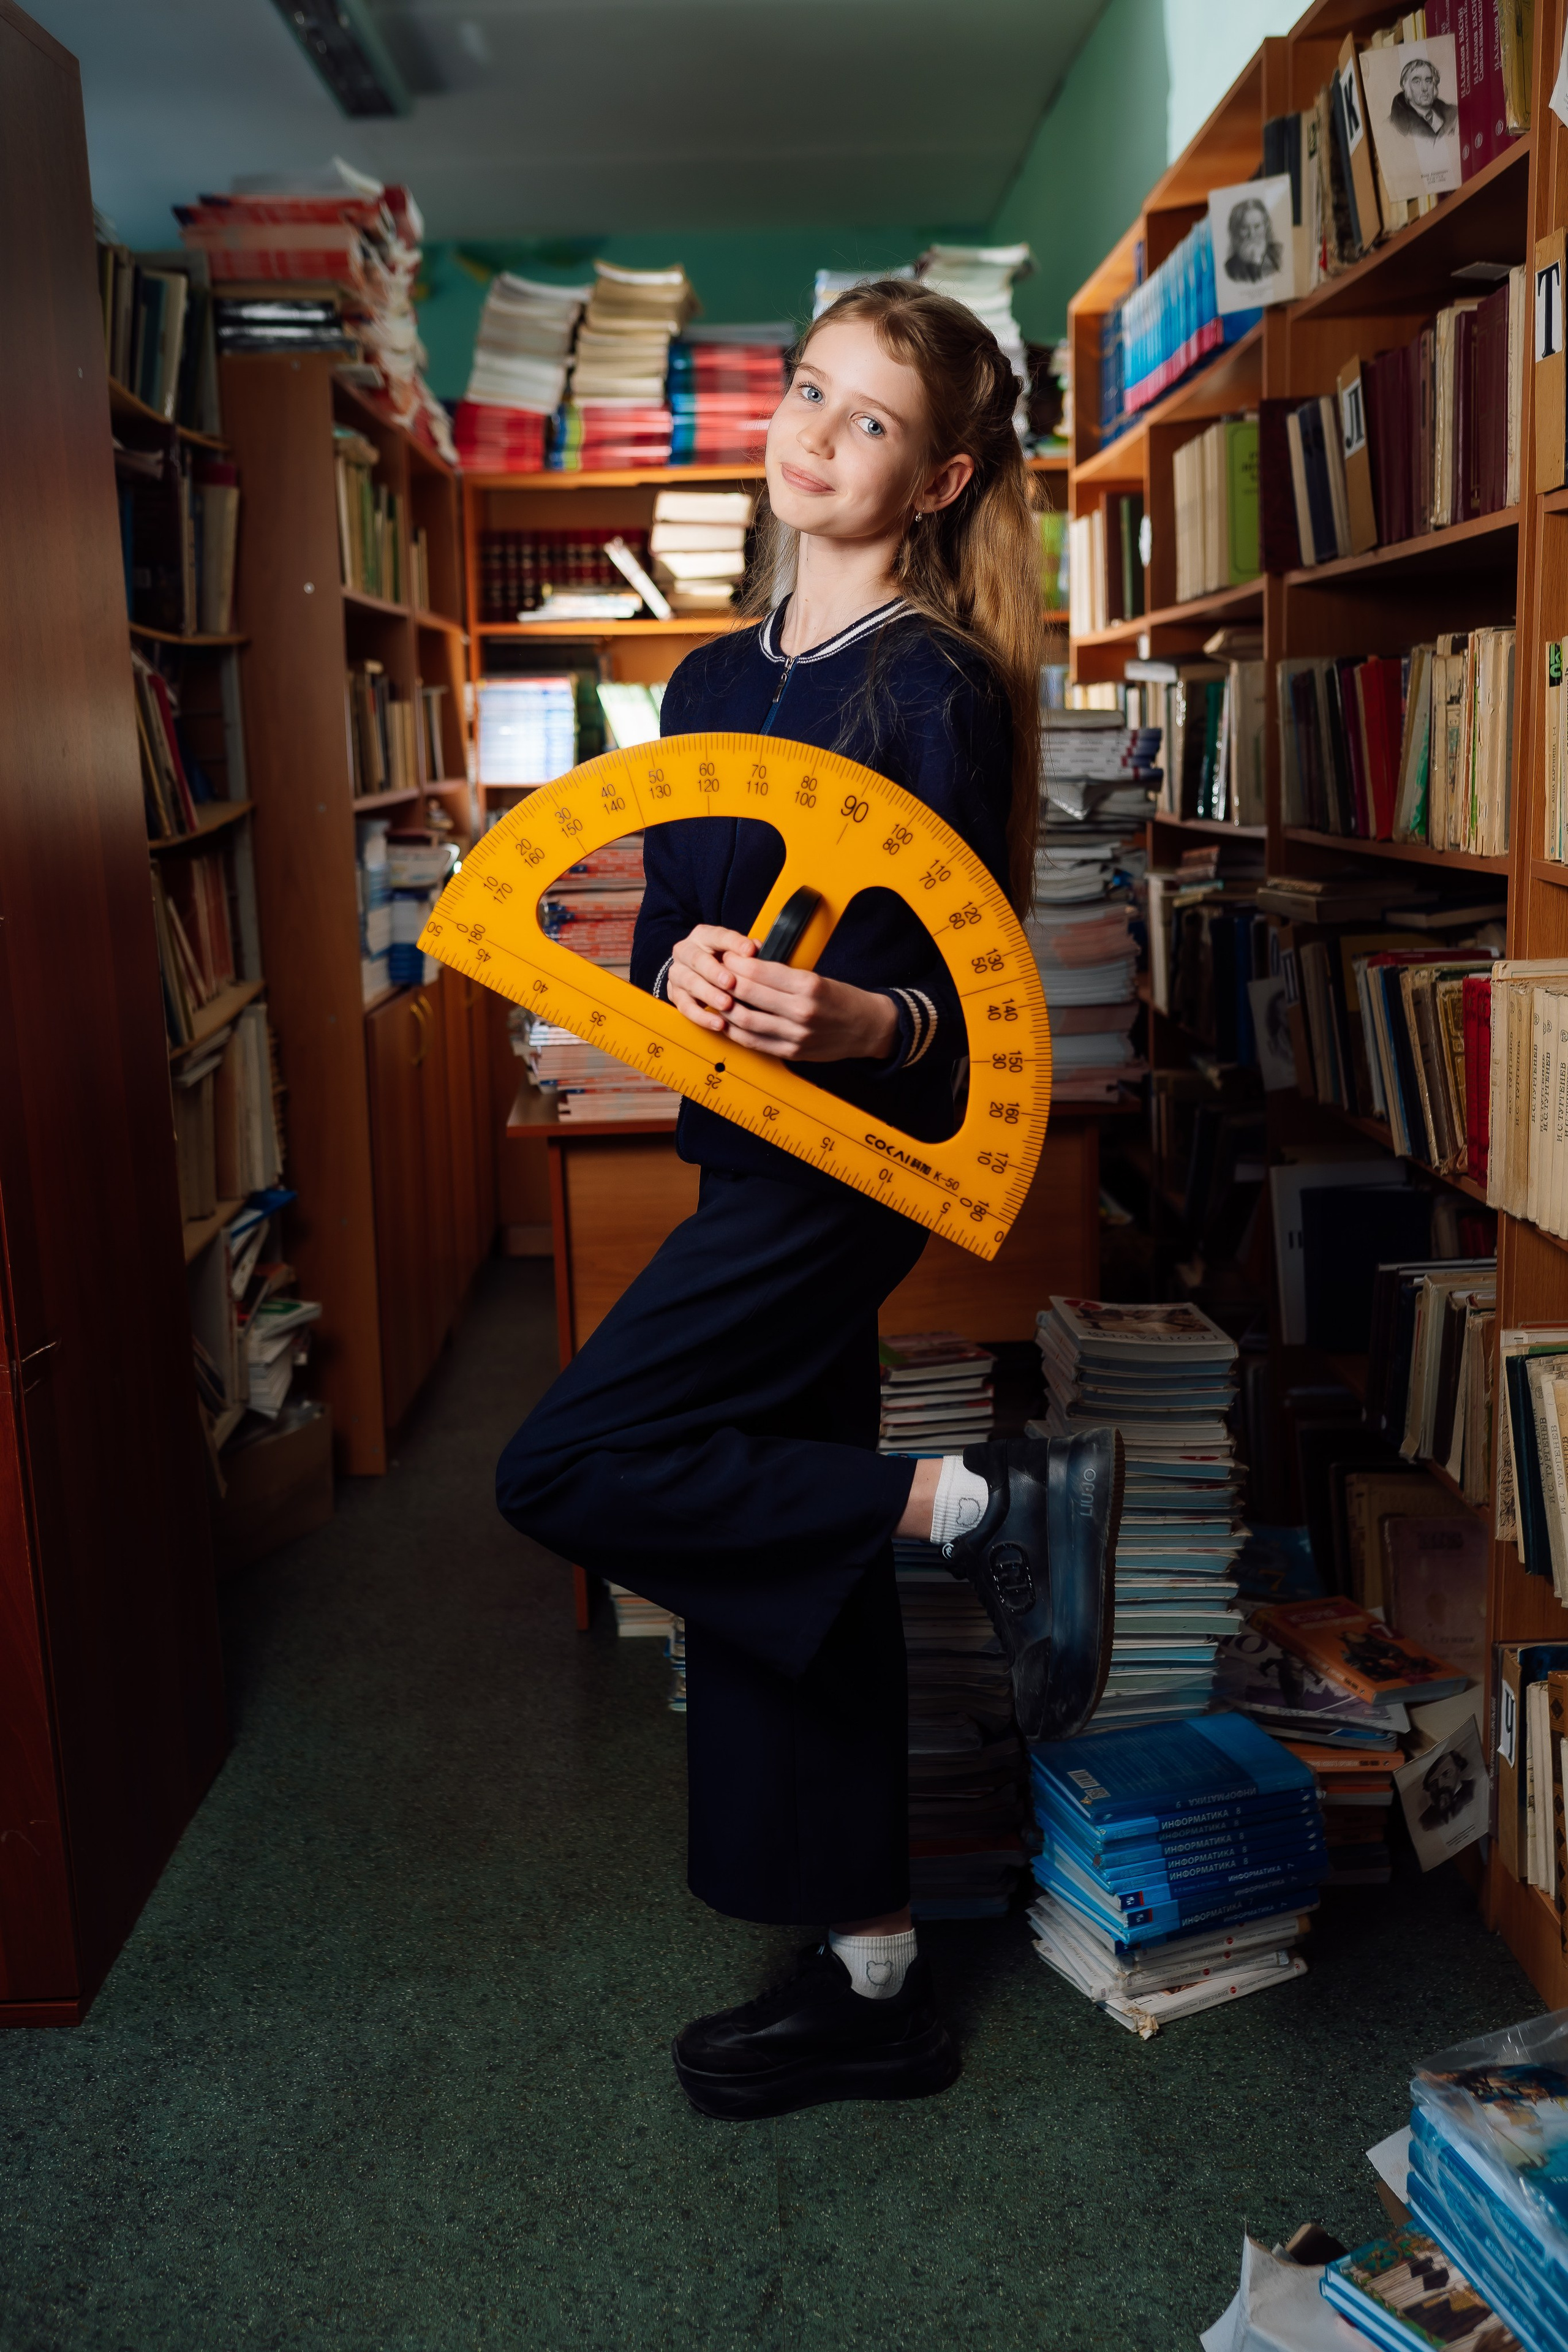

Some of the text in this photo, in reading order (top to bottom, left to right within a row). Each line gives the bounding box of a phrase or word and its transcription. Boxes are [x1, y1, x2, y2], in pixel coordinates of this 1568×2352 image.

[1344, 71, 1360, 140] К
[1537, 262, 1559, 358] Т
[648, 768, 665, 784] 50
[698, 762, 715, 777] 60
[751, 764, 767, 780] 70
[600, 783, 616, 799] 40
[648, 783, 672, 800] 130
[696, 778, 720, 794] 120
[745, 780, 769, 796] 110
[801, 775, 818, 791] 80
[602, 797, 626, 816] 140
[794, 791, 816, 809] 100
[840, 794, 869, 823] 90
[554, 807, 572, 824] 30
[560, 818, 583, 839] 150
[890, 823, 914, 845] 100
[515, 838, 533, 856] 20
[882, 838, 900, 856] 80
[524, 846, 546, 869] 160
[929, 859, 951, 883] 110
[483, 876, 499, 893] 10
[919, 872, 937, 891] 70
[493, 882, 513, 905] 170
[948, 912, 966, 930] 60
[962, 900, 982, 925] 120
[427, 921, 443, 938] 50
[456, 923, 469, 934] 0
[467, 923, 486, 946] 180
[475, 948, 492, 963] 45
[986, 948, 1005, 972] 130
[971, 957, 987, 974] 50
[532, 979, 549, 995] 40
[589, 1011, 606, 1026] 35
[986, 1005, 1001, 1022] 40
[1001, 997, 1019, 1022] 140
[647, 1042, 665, 1058] 30
[992, 1053, 1007, 1069] 30
[1008, 1050, 1023, 1074] 150
[704, 1074, 722, 1090] 25
[762, 1105, 780, 1121] 20
[989, 1101, 1004, 1118] 20
[1003, 1102, 1020, 1125] 160
[820, 1137, 835, 1152] 15
[976, 1150, 992, 1166] 10
[990, 1152, 1009, 1175] 170
[878, 1168, 894, 1183] 10
[933, 1170, 960, 1191] K-50
[940, 1202, 951, 1215] 5
[959, 1197, 973, 1209] 0
[969, 1200, 991, 1223] 180
[993, 1230, 1005, 1243] 0
[1539, 1417, 1553, 1478] ТУРГЕНЕВ
[1551, 1424, 1563, 1488] ТУРГЕНЕВ
[1188, 1787, 1257, 1807] ИНФОРМАТИКА
[1161, 1809, 1229, 1830] ИНФОРМАТИКА
[1159, 1823, 1226, 1842] ИНФОРМАТИКА
[1164, 1834, 1232, 1855] ИНФОРМАТИКА
[1167, 1848, 1235, 1869] ИНФОРМАТИКА
[1169, 1860, 1237, 1880] ИНФОРМАТИКА
[1227, 1865, 1281, 1883] ИНФОРМАТИКА
[1234, 1879, 1285, 1898] ИНФОРМАТИКА
[1182, 1901, 1243, 1927] ИНФОРМАТИКА
